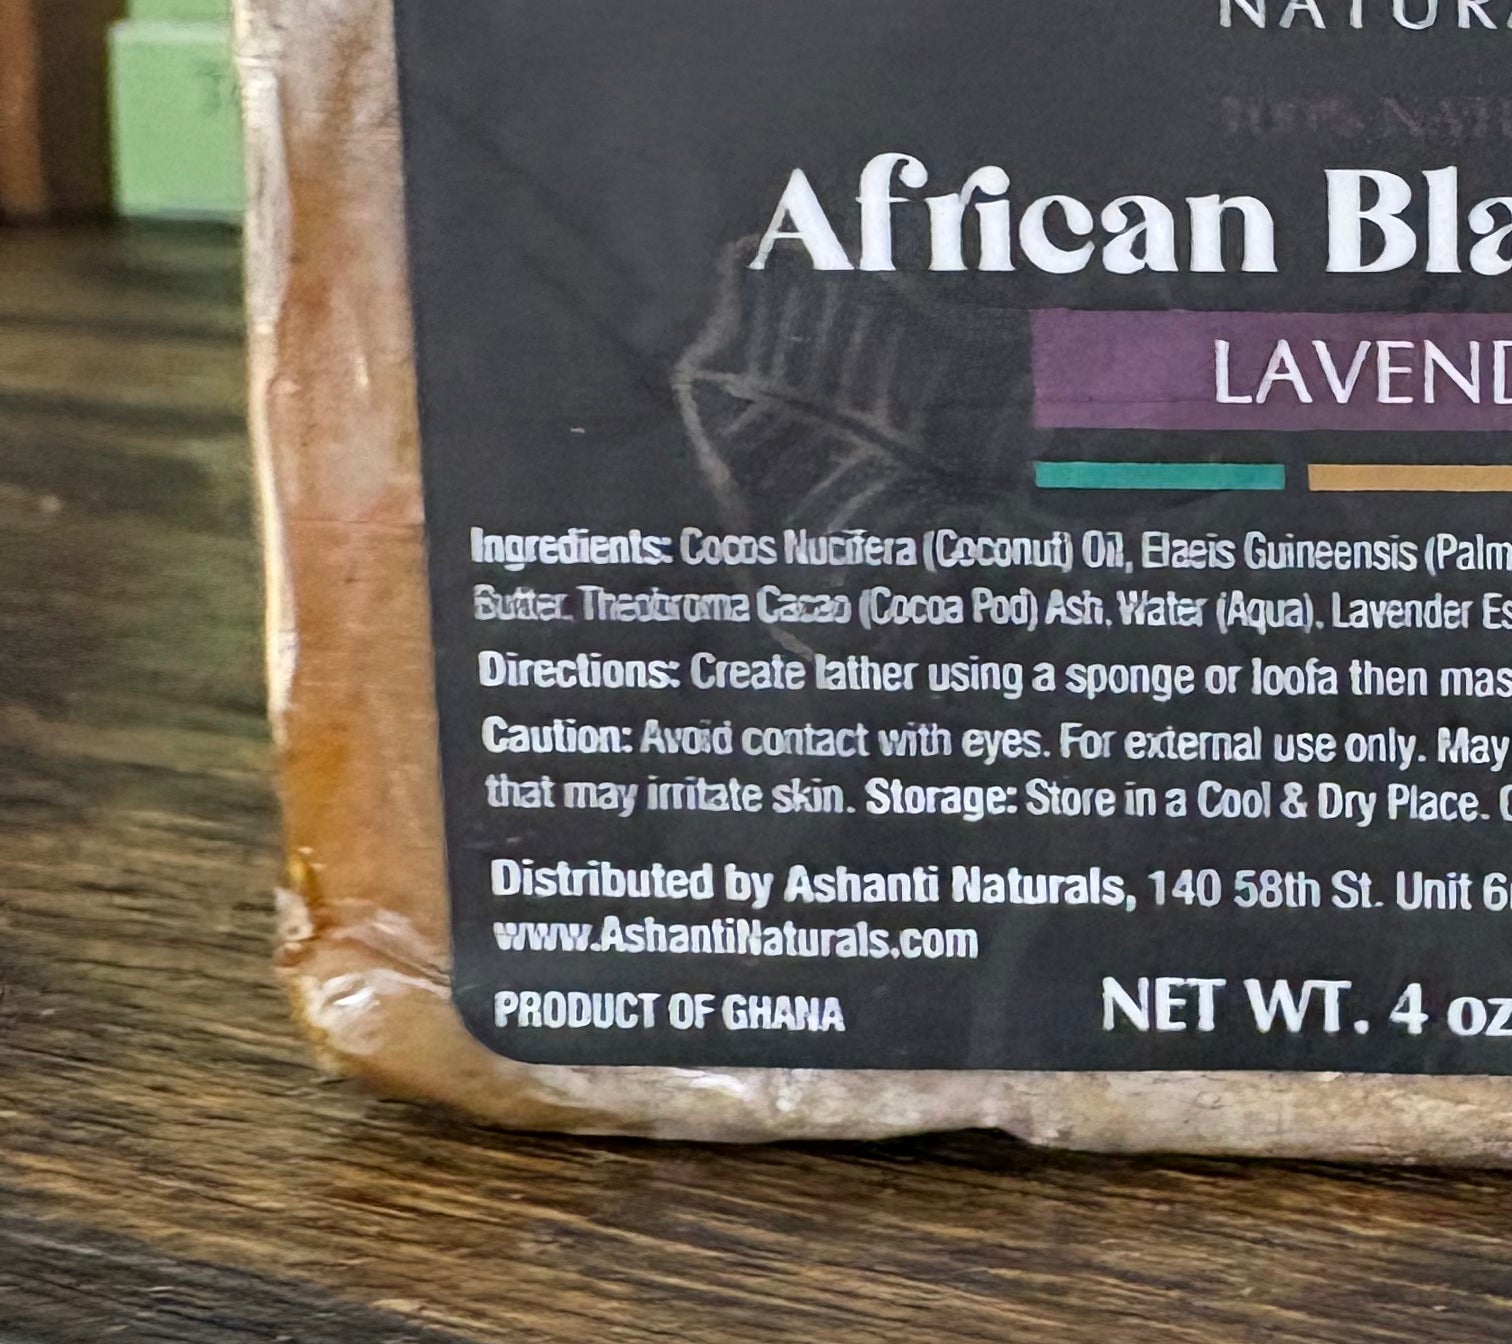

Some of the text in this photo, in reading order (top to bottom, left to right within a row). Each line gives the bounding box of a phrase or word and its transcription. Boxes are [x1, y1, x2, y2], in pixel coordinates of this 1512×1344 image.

[749, 153, 1280, 273] African
[470, 526, 673, 572] Ingredients:
[680, 527, 777, 567] Cocos
[784, 528, 916, 567] Nucifera
[923, 528, 1073, 573] (Coconut)
[1082, 529, 1134, 574] Oil,
[1244, 530, 1418, 573] Guineensis
[859, 587, 964, 630] (Cocoa
[972, 587, 1039, 632] Pod)
[1116, 589, 1209, 628] Water
[1332, 592, 1473, 631] Lavender
[478, 649, 681, 689] Directions:
[690, 652, 806, 690] Create
[815, 652, 919, 690] lather
[928, 656, 1024, 699] using
[1031, 661, 1057, 692] a
[1064, 661, 1196, 702] sponge
[1204, 663, 1244, 696] or
[1251, 657, 1338, 696] loofa
[1348, 659, 1428, 697] then
[481, 715, 632, 755] Caution:
[639, 719, 733, 757] Avoid
[741, 721, 870, 758] contact
[877, 721, 952, 758] with
[961, 726, 1051, 766] eyes.
[1060, 721, 1117, 760] For
[1123, 724, 1262, 762] external
[1273, 731, 1337, 764] use
[1344, 727, 1426, 772] only.
[1437, 727, 1509, 772] May
[484, 773, 556, 810] that
[563, 778, 635, 818] may
[646, 775, 763, 815] irritate
[772, 778, 857, 815] skin.
[865, 777, 1018, 822] Storage:
[1025, 778, 1116, 818] Store
[1124, 781, 1156, 817] in
[1165, 787, 1187, 818] a
[1198, 780, 1271, 820] Cool
[1280, 782, 1308, 820] &
[1318, 782, 1376, 828] Dry
[1388, 783, 1491, 822] Place.
[491, 858, 712, 903] Distributed
[724, 862, 774, 909] by
[782, 864, 939, 905] Ashanti
[950, 865, 1137, 912] Naturals,
[1152, 868, 1222, 908] 140
[1233, 869, 1321, 910] 58th
[1330, 870, 1383, 910] St.
[1396, 870, 1473, 911] Unit
[493, 914, 980, 960] www.AshantiNaturals.com
[495, 990, 846, 1033] PRODUCT OF GHANA
[1102, 976, 1227, 1033] NET
[1242, 977, 1370, 1035] WT.
[1388, 982, 1428, 1033] 4
